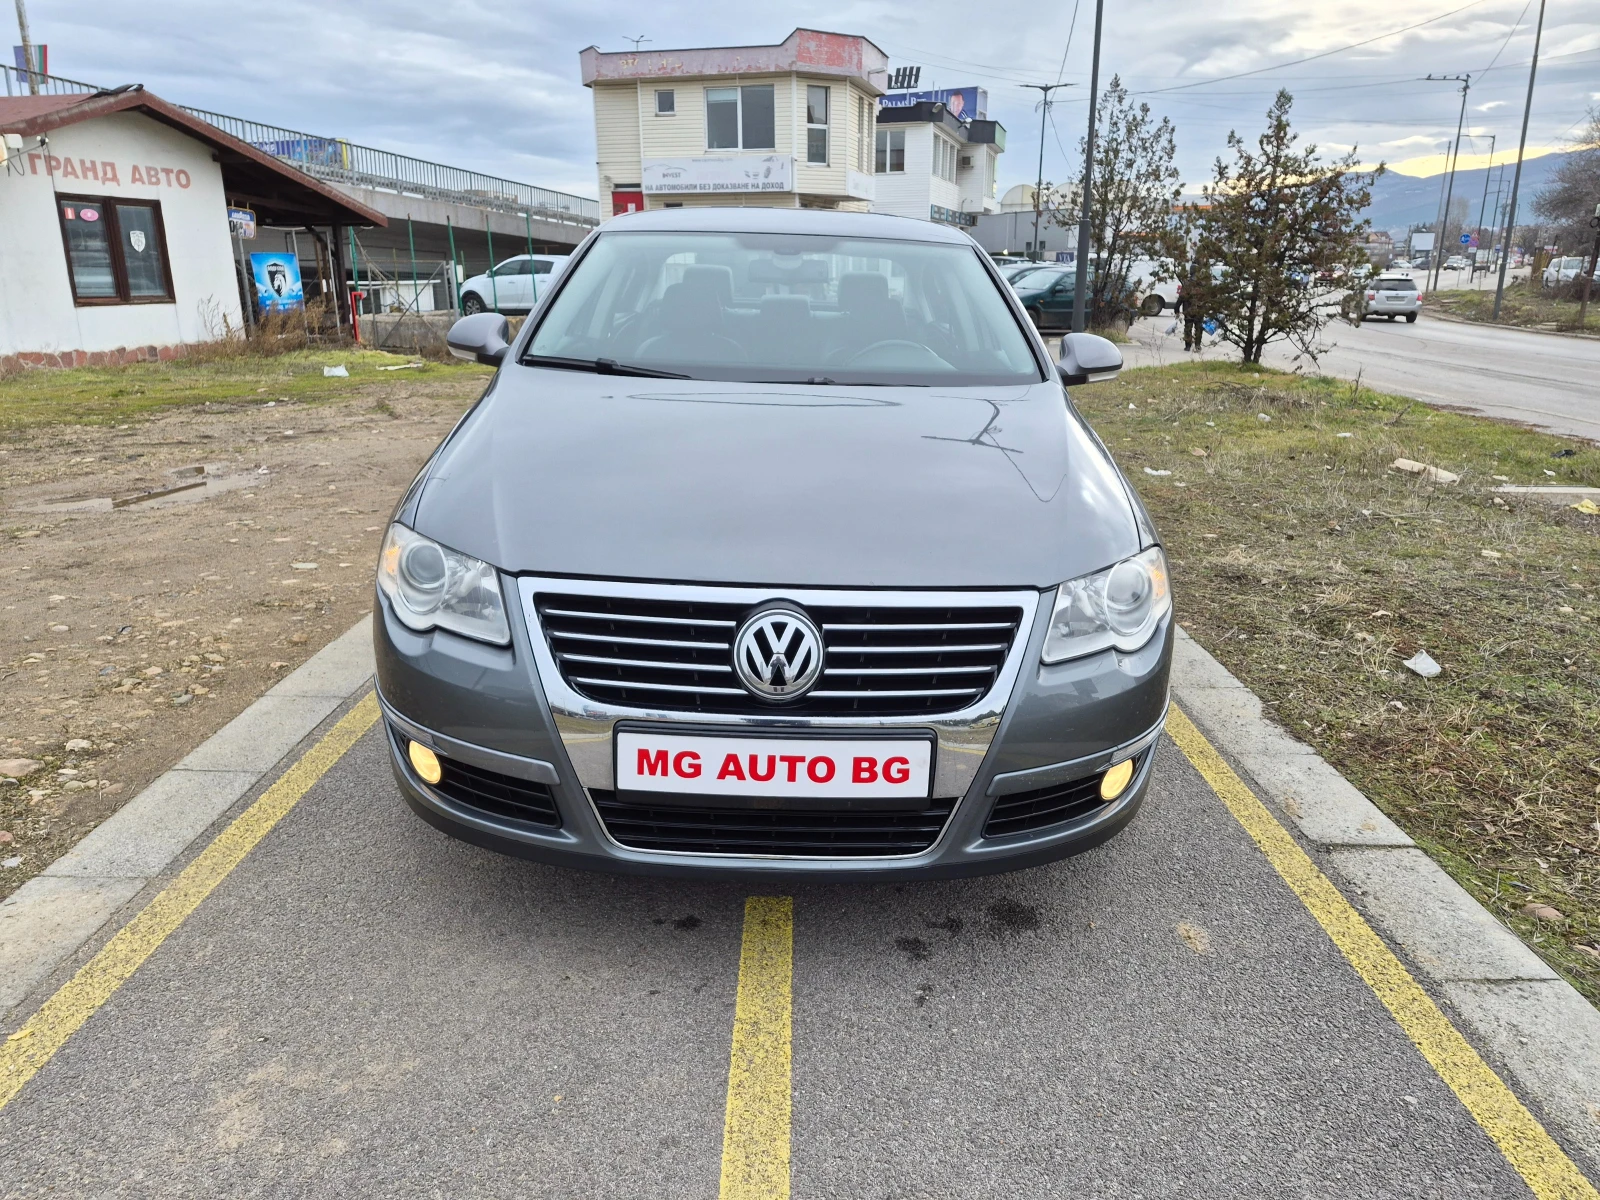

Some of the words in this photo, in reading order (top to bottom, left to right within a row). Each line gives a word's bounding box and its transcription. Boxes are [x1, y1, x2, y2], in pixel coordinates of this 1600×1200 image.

[27, 152, 120, 187] ГРАНД
[131, 164, 191, 189] АВТО
[655, 183, 698, 191] АВТОМОБИЛИ
[712, 182, 750, 191] ДОКАЗВАНЕ
[751, 182, 760, 190] НА
[761, 182, 784, 190] ДОХОД
[637, 748, 701, 778] MG
[716, 753, 836, 783] AUTO
[851, 756, 911, 784] BG
